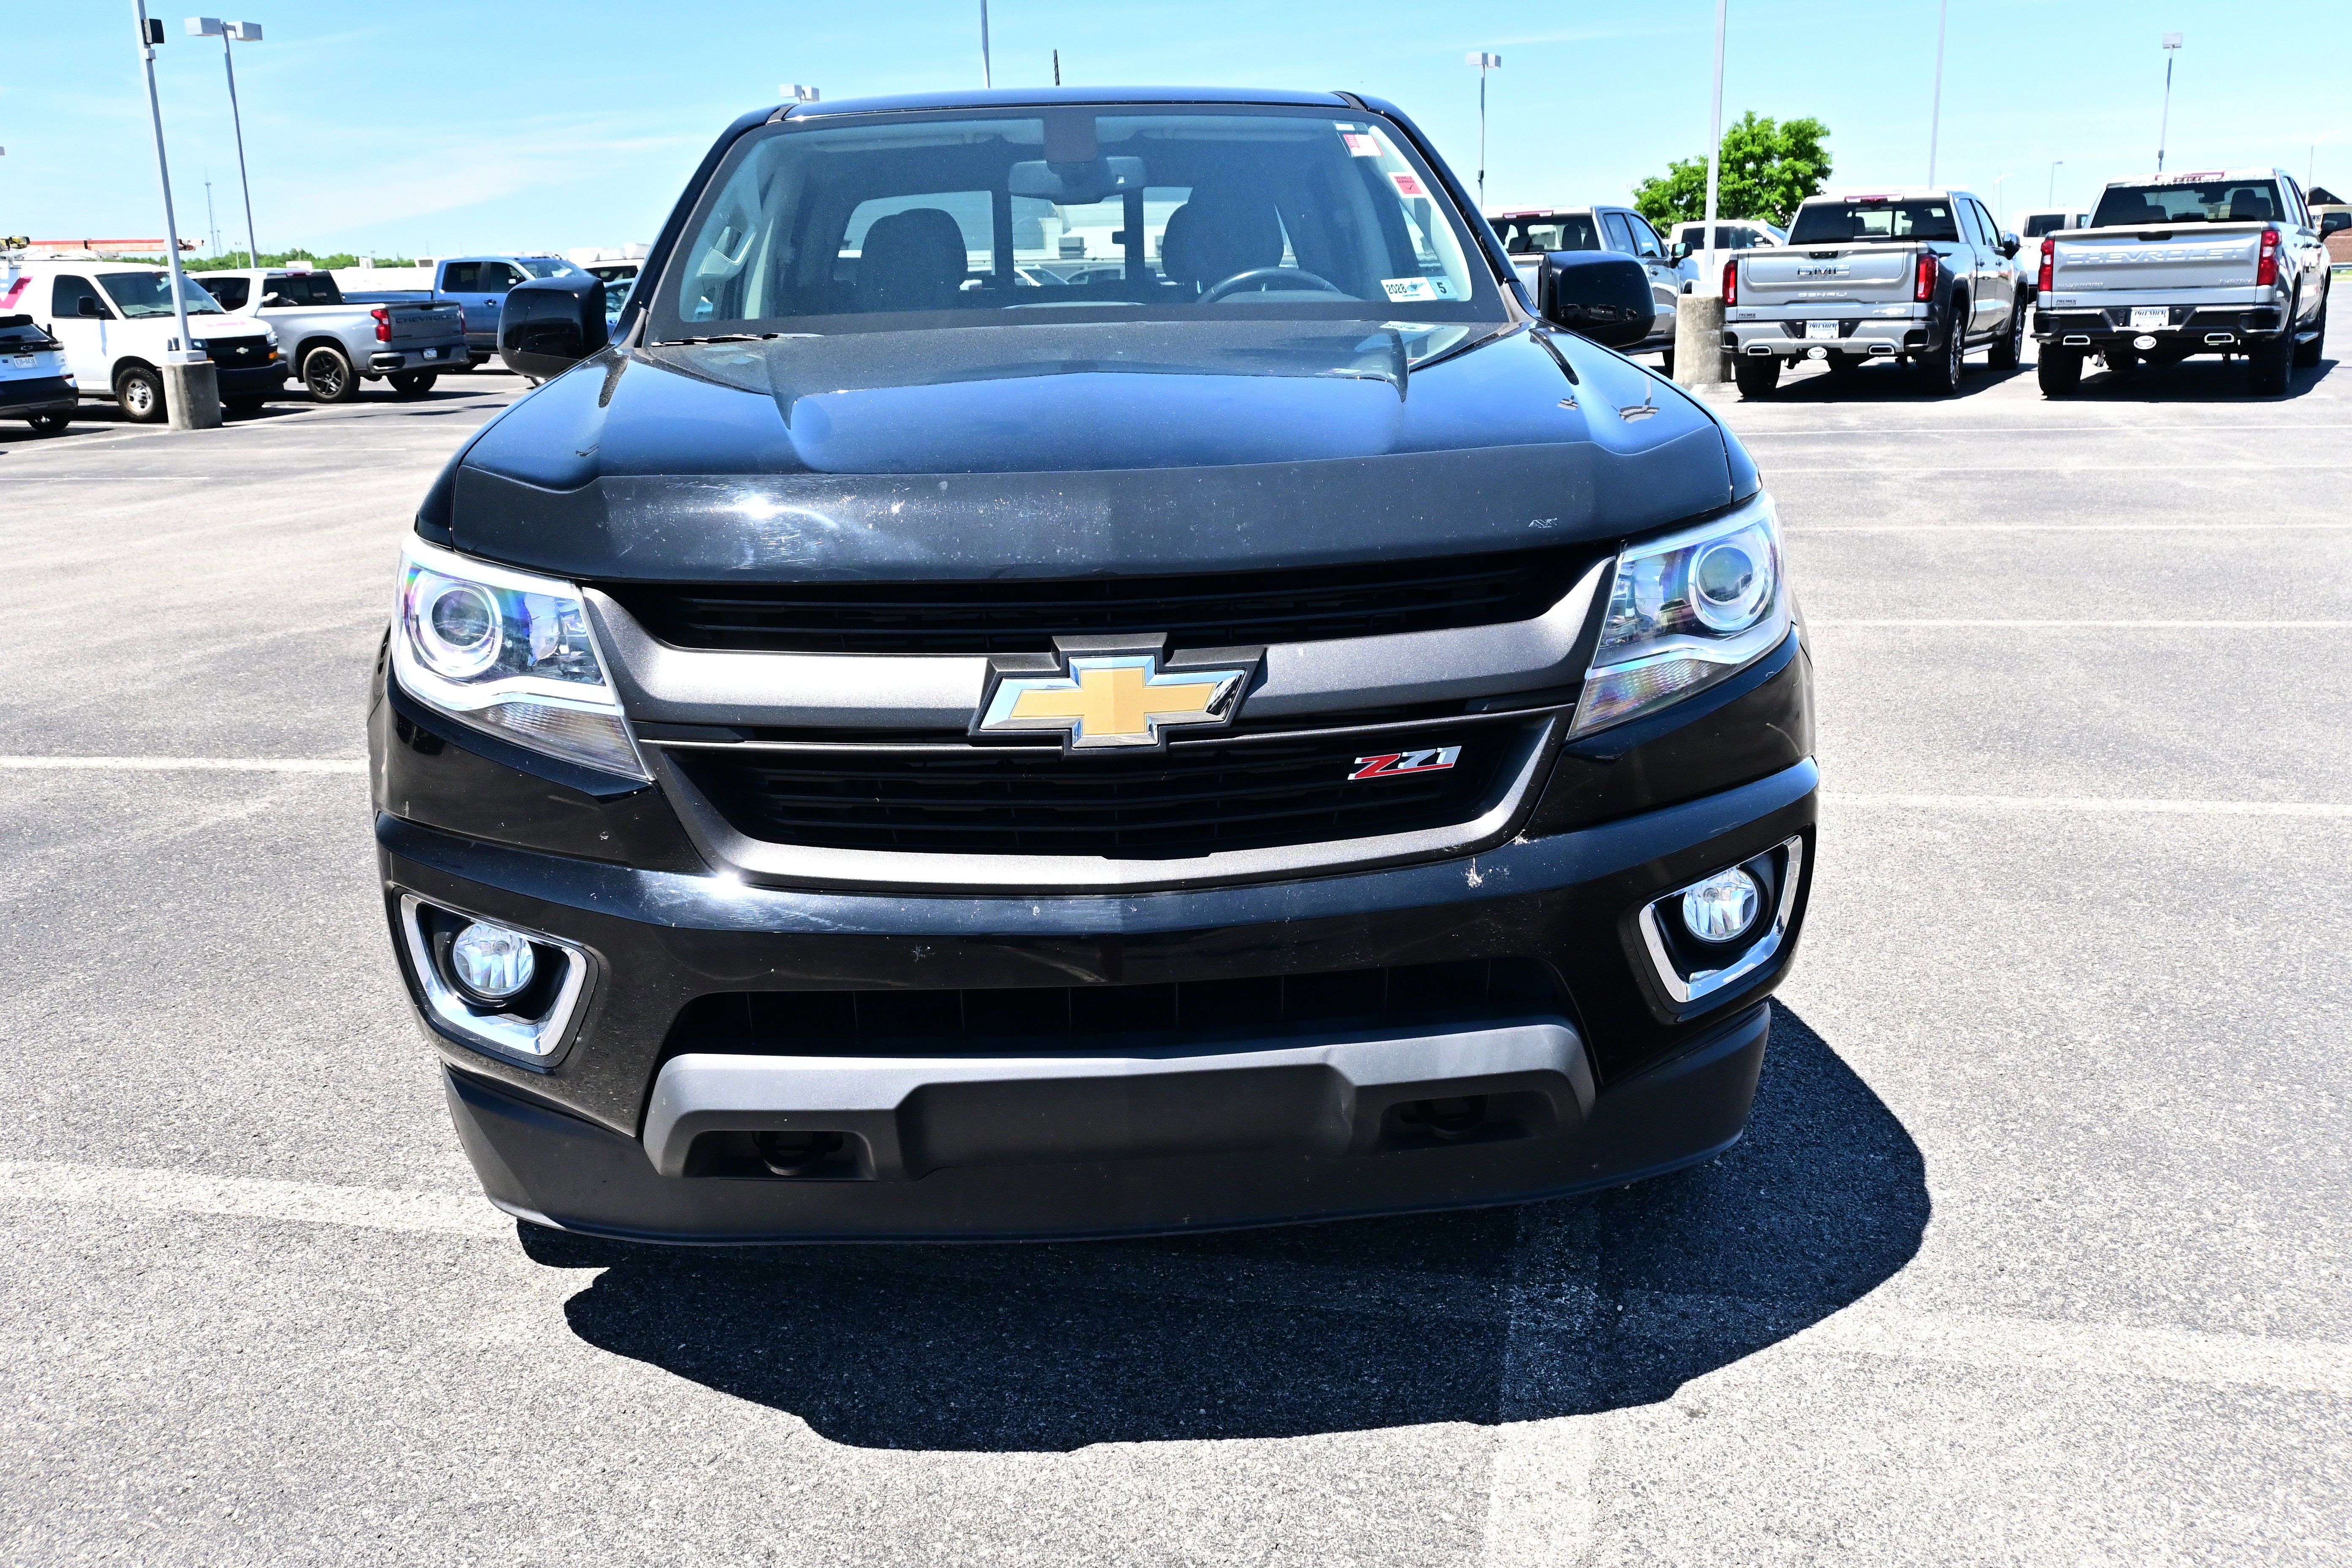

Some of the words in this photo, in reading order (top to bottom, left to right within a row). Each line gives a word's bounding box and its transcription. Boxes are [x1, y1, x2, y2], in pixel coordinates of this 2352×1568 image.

[2066, 248, 2245, 264] CHEVROLET
[1798, 265, 1850, 278] GMC
[1386, 283, 1407, 294] 2028
[1436, 282, 1447, 294] 5
[395, 314, 458, 323] CHEVROLET
[2134, 310, 2166, 318] PREMIER
[1809, 322, 1837, 330] PREMIER
[1348, 746, 1462, 780] Z71
